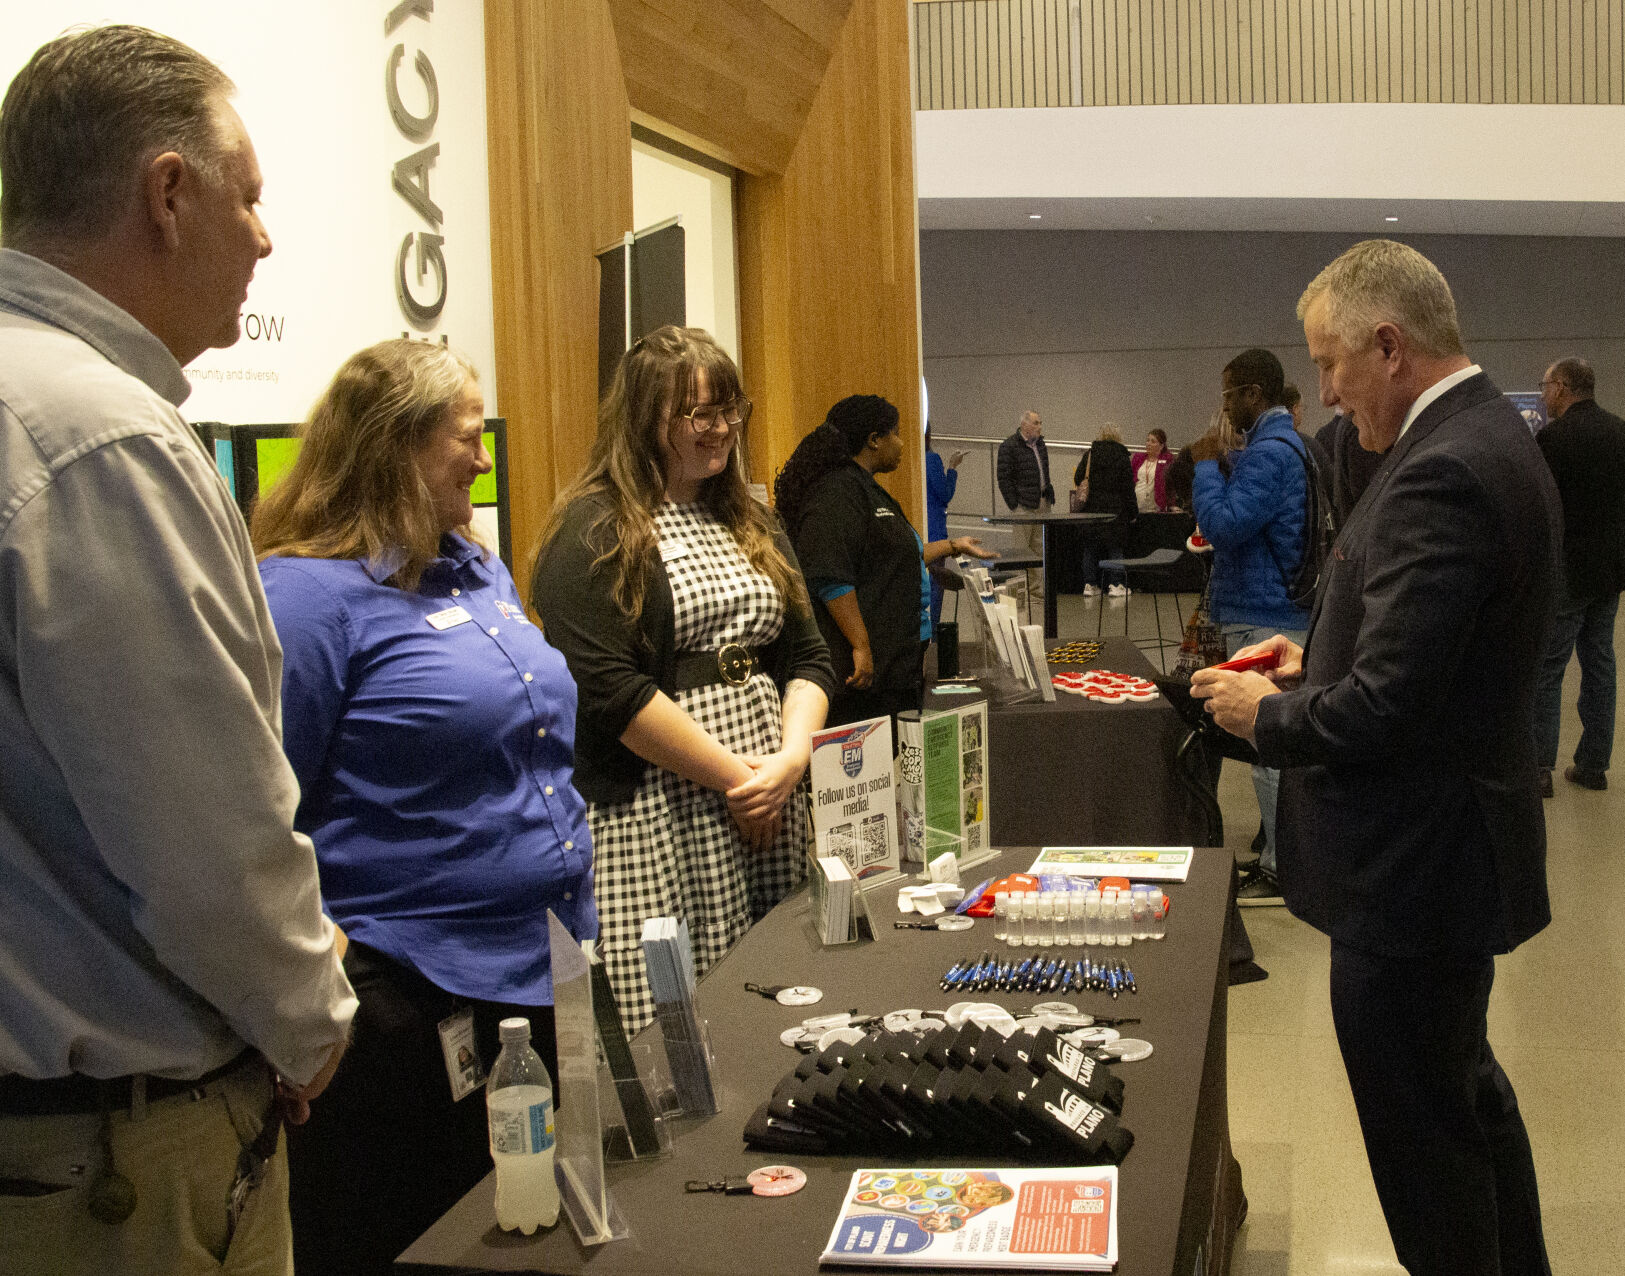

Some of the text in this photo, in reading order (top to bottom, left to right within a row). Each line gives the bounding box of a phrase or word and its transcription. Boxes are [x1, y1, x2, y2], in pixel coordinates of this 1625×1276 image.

[240, 313, 285, 342] ow
[183, 367, 279, 384] mmunity and diversity
[844, 747, 863, 764] EM
[817, 772, 891, 807] Follow us on social
[843, 795, 869, 817] media!
[1077, 1056, 1096, 1088] PLANO
[1075, 1109, 1105, 1139] PLANO
